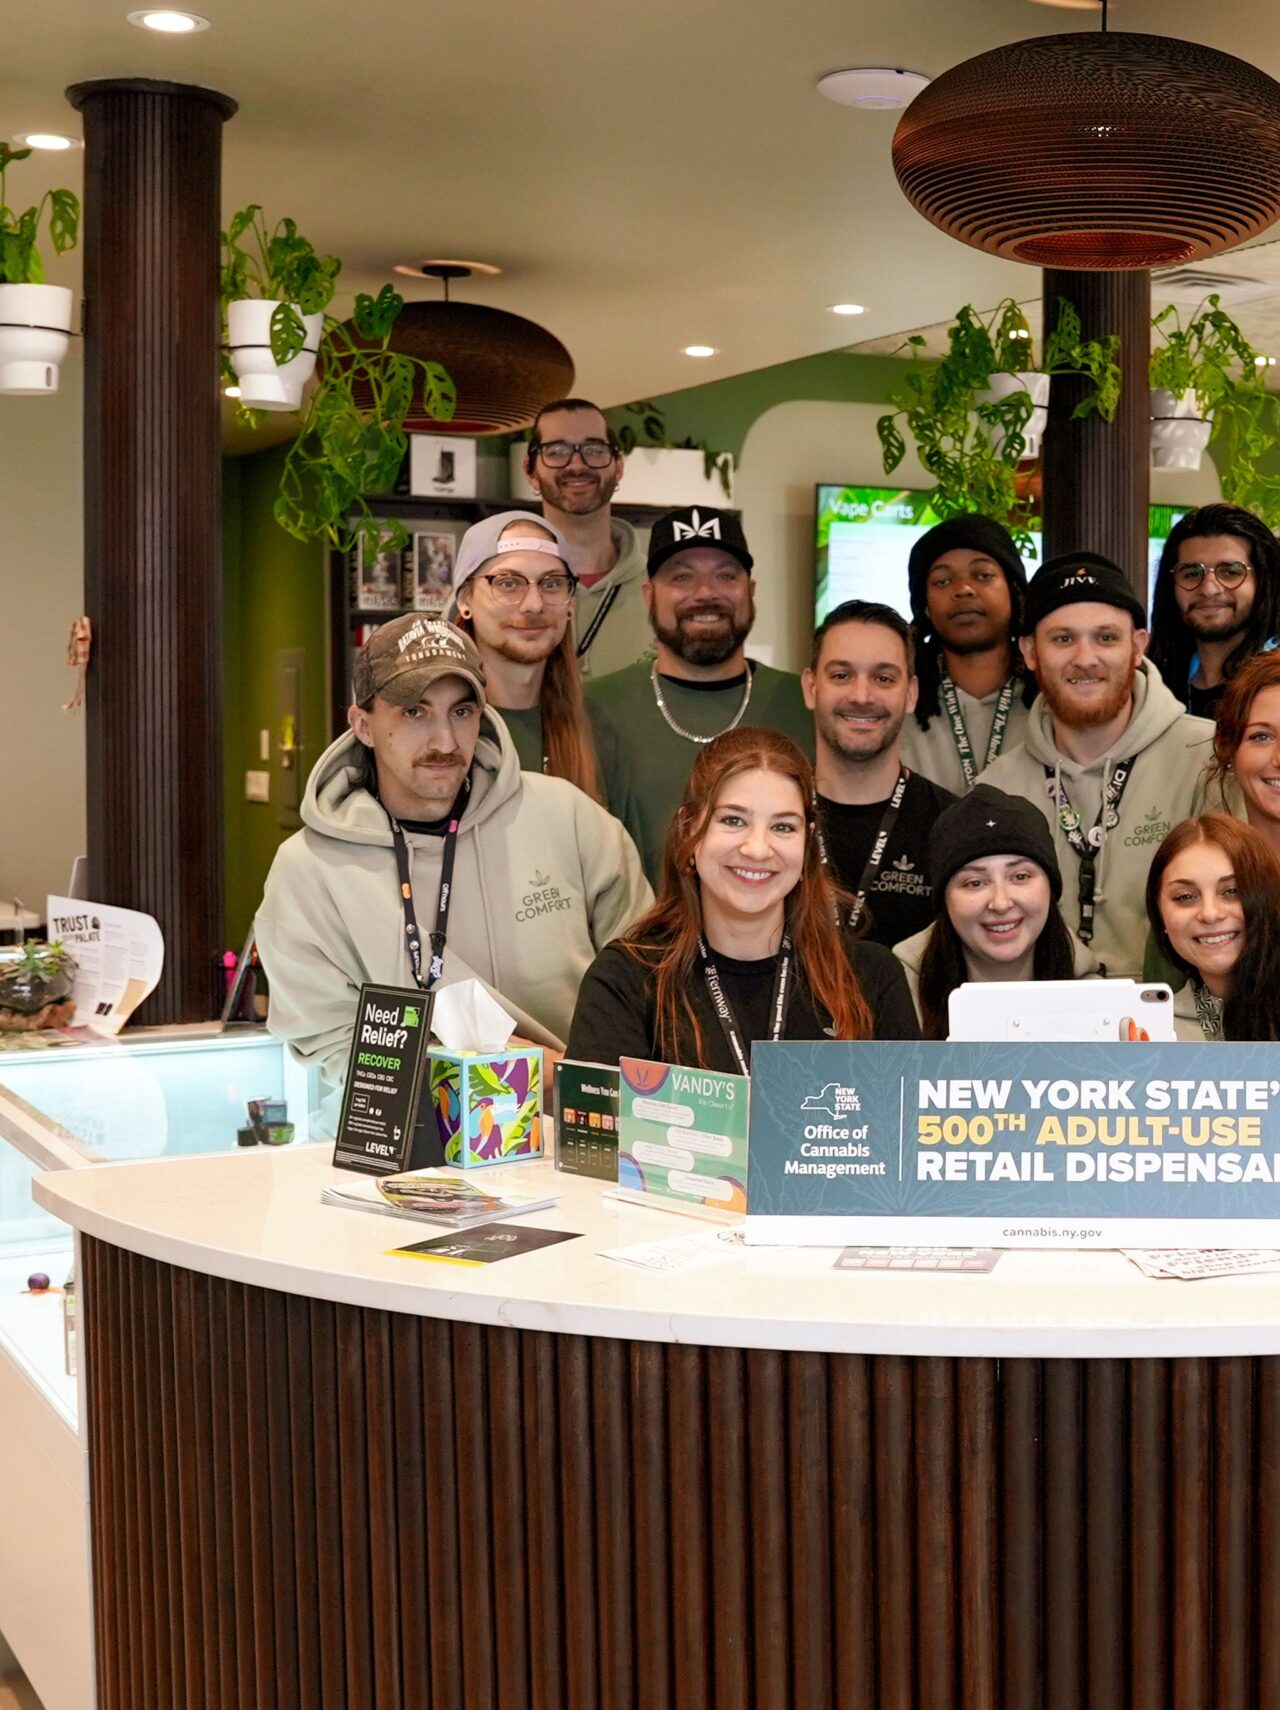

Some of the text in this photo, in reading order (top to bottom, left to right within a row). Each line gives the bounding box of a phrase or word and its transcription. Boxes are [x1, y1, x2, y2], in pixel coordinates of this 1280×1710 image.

[828, 498, 914, 520] Vape Carts
[891, 783, 906, 808] LEVEL
[1134, 822, 1172, 837] GREEN
[1124, 833, 1166, 848] COMFO
[869, 836, 888, 866] LEVEL
[880, 870, 924, 884] GREEN
[52, 914, 89, 934] TRUST
[708, 974, 731, 1020] Fernway
[364, 1002, 400, 1026] Need
[360, 1024, 408, 1049] Relief?
[358, 1052, 401, 1070] RECOVER
[671, 1072, 736, 1100] VANDY'S
[835, 1088, 856, 1096] NEW
[918, 1079, 1013, 1110] NEW
[1021, 1080, 1136, 1110] YORK
[834, 1103, 861, 1112] STATE
[835, 1096, 859, 1104] YORK
[804, 1124, 868, 1140] Office of
[918, 1113, 1261, 1147] 500TH ADULT-USE
[365, 1141, 390, 1157] LEVEL
[800, 1143, 870, 1158] Cannabis
[784, 1160, 886, 1178] Management
[916, 1151, 1054, 1182] RETAIL
[1002, 1227, 1102, 1239] cannabis.ny.gov
